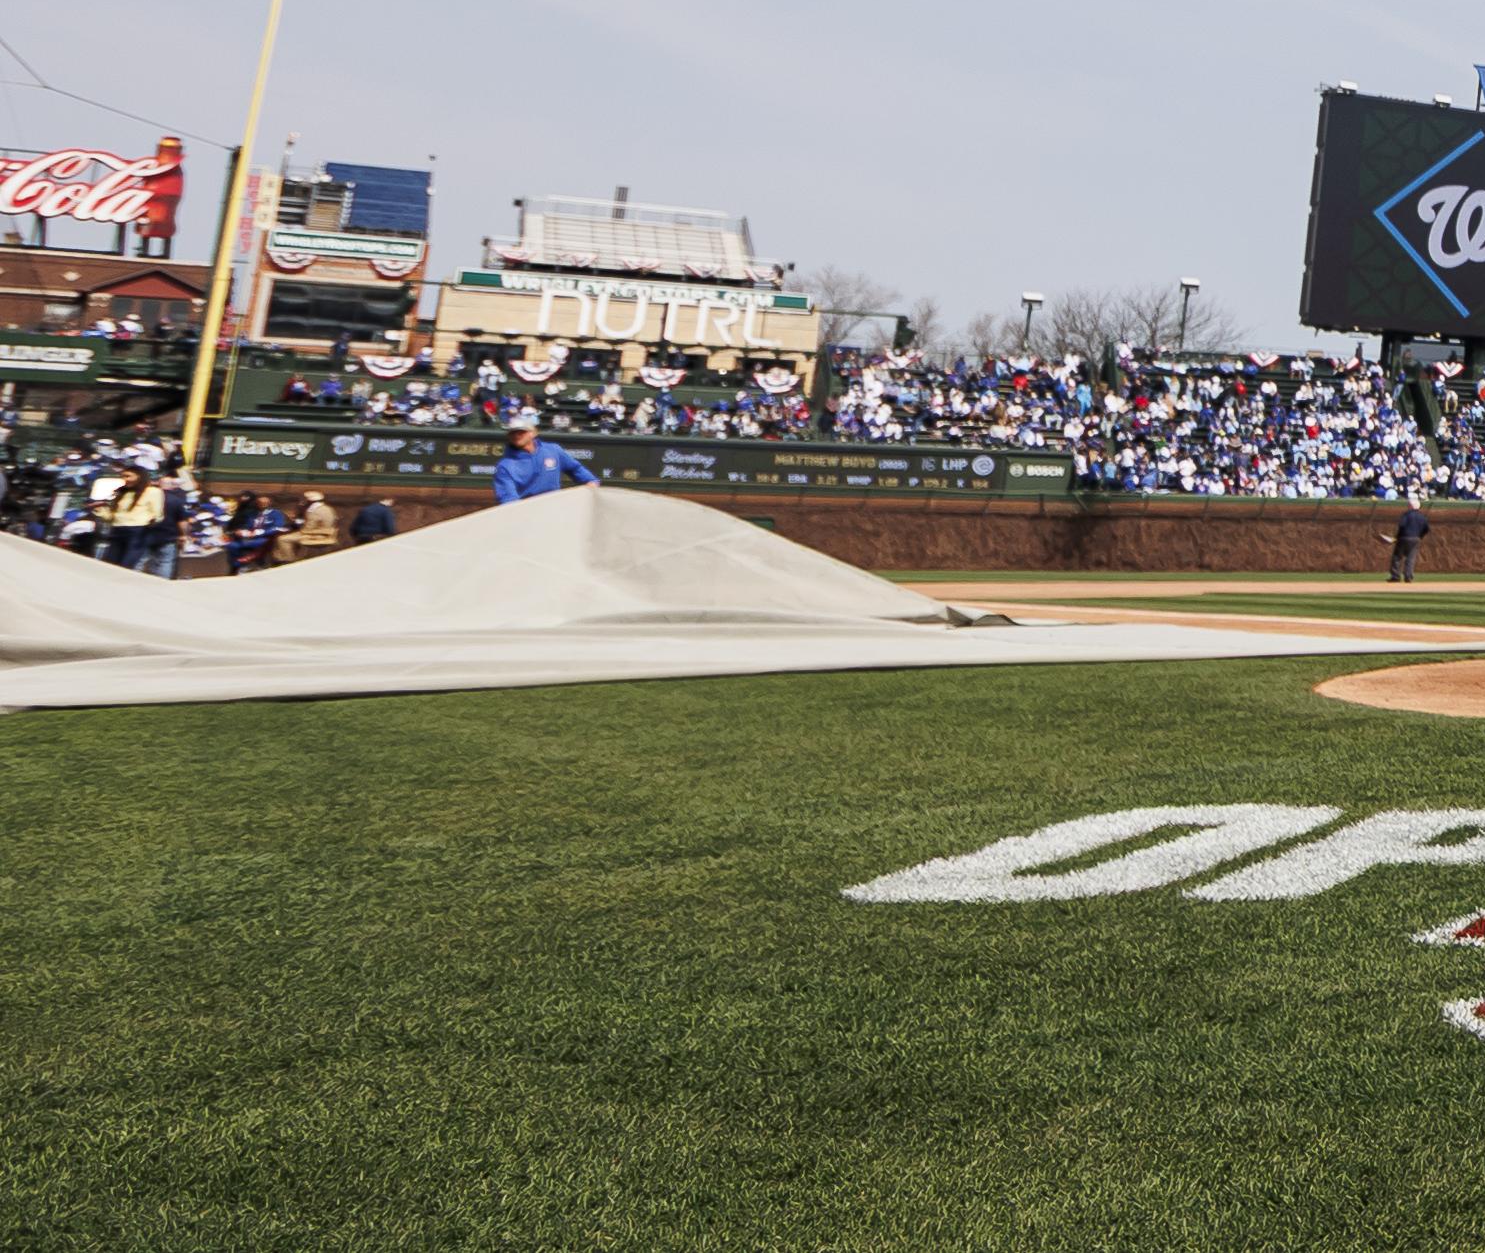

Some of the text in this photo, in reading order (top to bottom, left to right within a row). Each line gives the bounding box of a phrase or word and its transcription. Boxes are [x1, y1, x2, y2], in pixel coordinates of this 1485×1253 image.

[220, 435, 315, 460] Harvey
[942, 457, 968, 471] LHP
[1026, 464, 1066, 477] BOSCH
